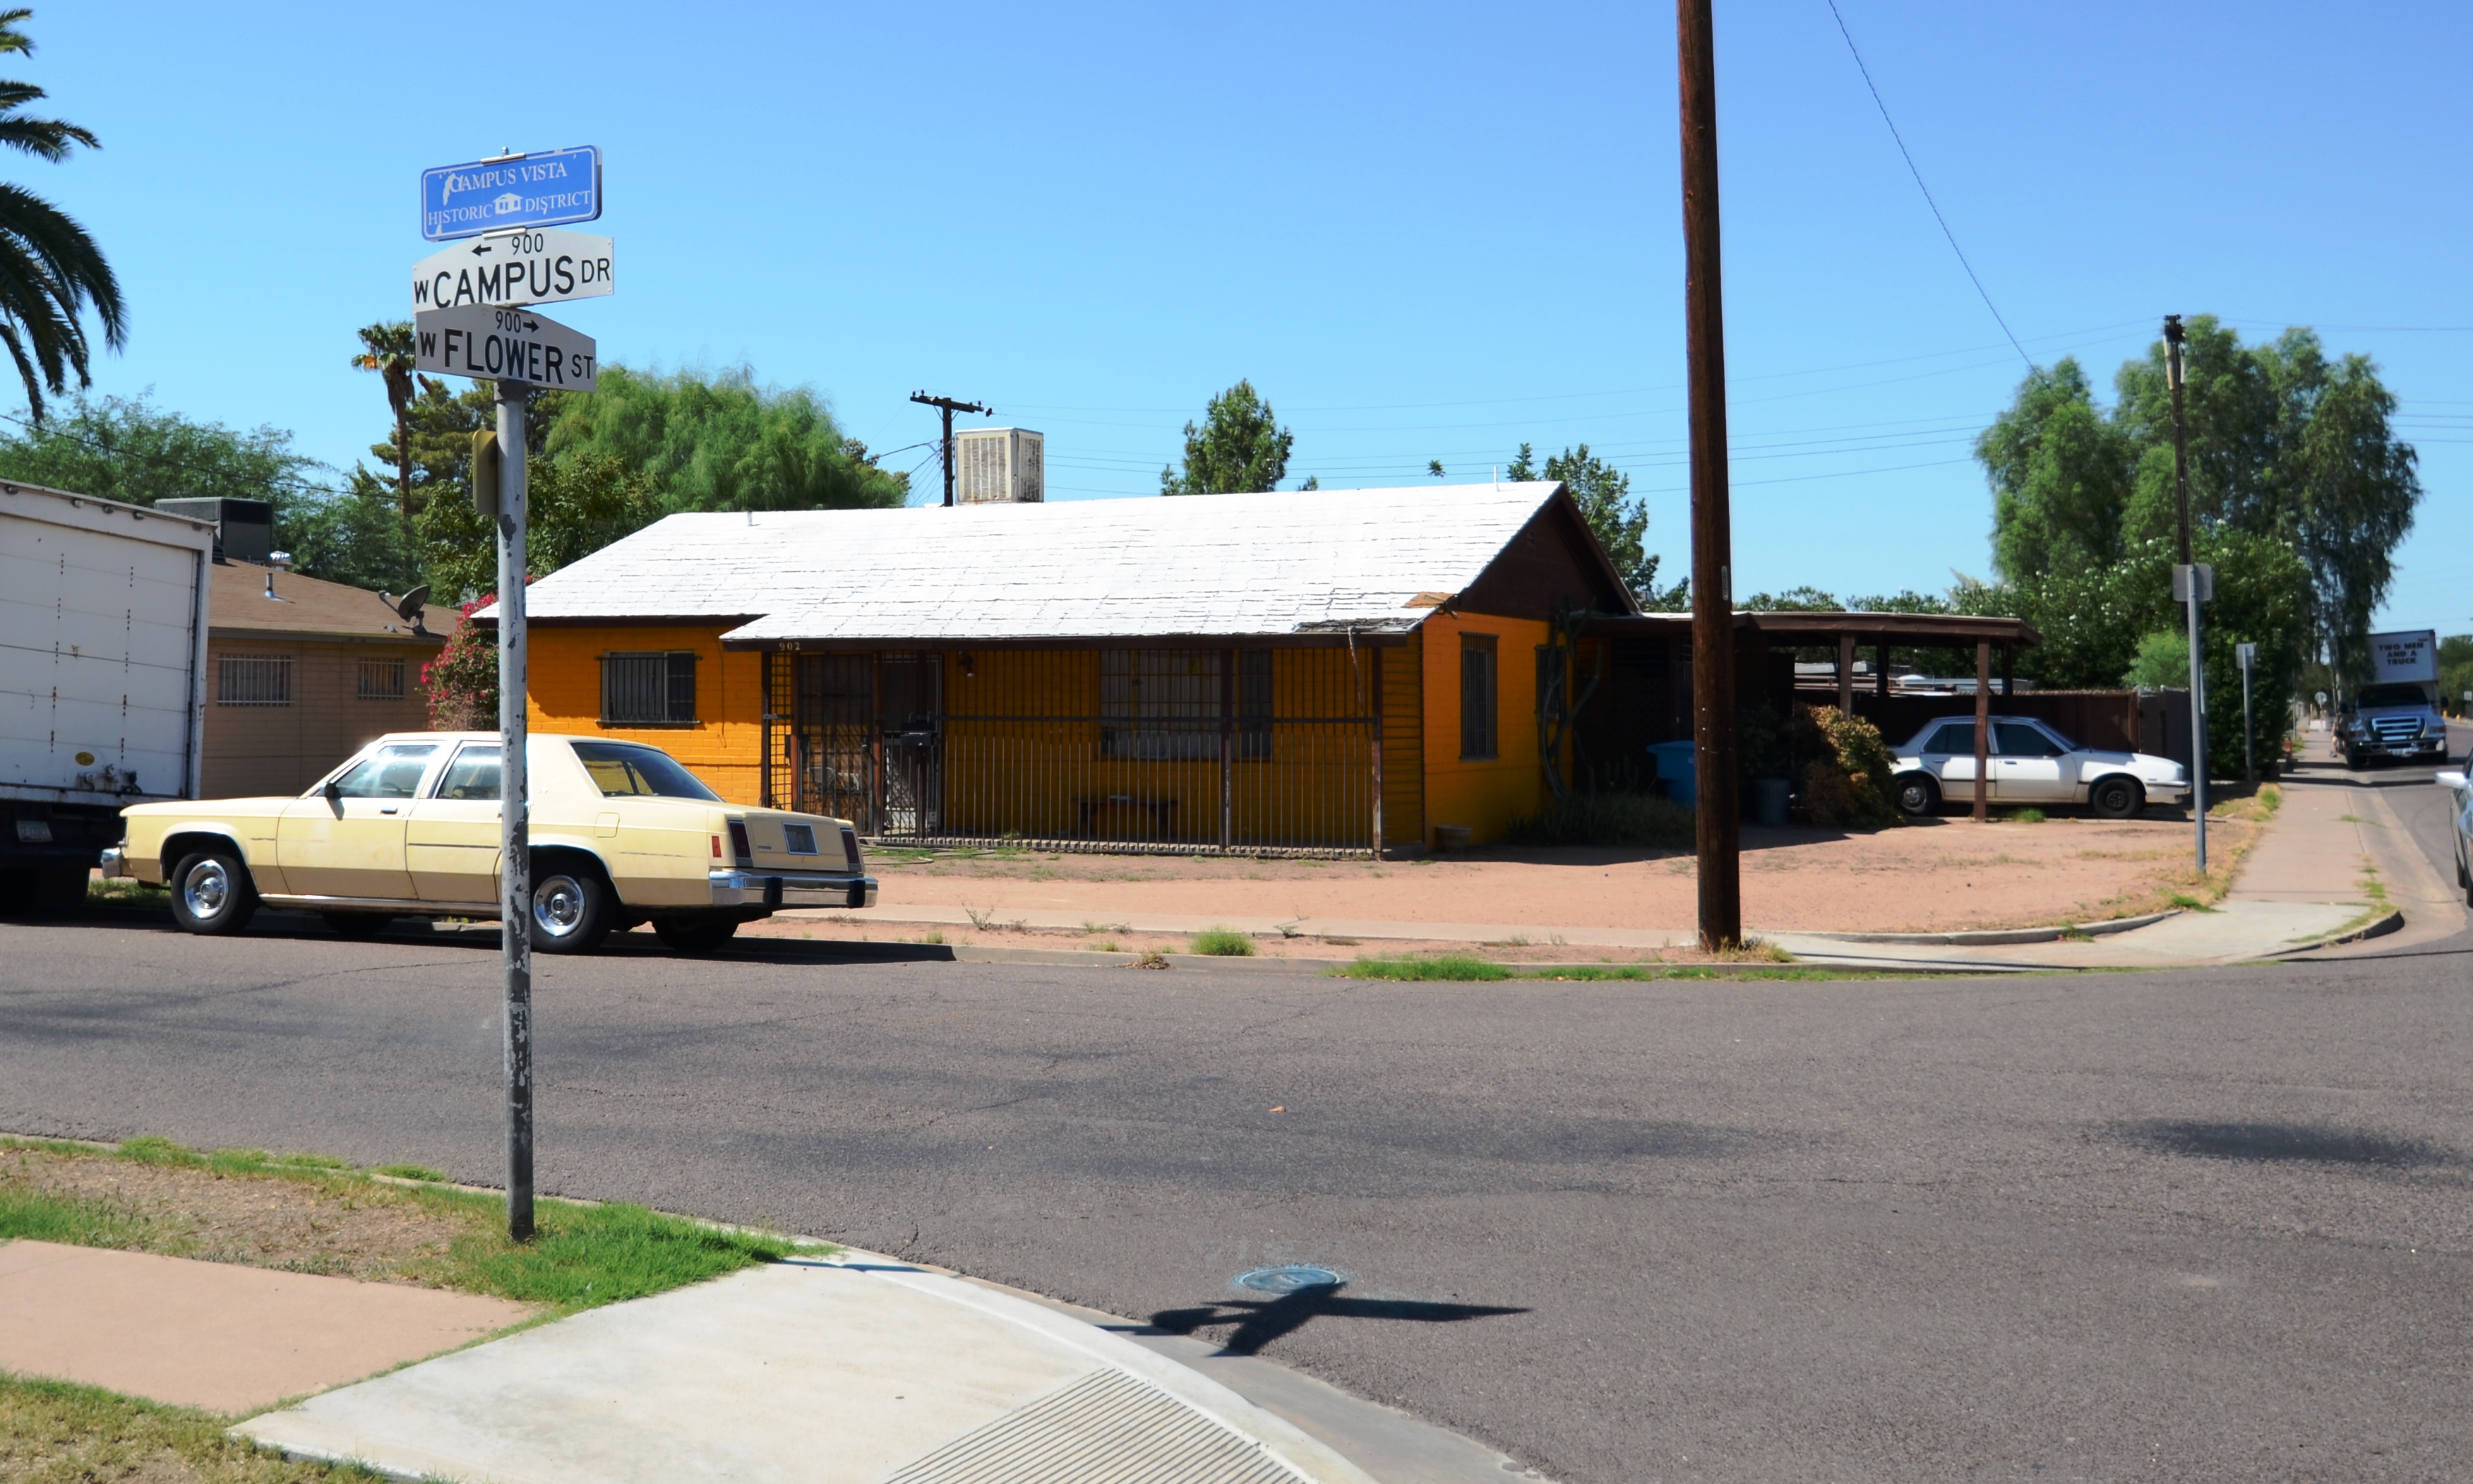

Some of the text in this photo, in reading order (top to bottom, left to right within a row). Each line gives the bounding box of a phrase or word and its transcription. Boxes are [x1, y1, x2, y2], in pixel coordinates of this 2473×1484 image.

[450, 162, 568, 193] CAMPUS VISTA
[428, 190, 591, 225] HISTORIC DISTRICT
[511, 233, 544, 256] 900
[414, 255, 611, 309] W CAMPUS DR
[496, 310, 522, 333] 900
[419, 328, 594, 385] W FLOWER ST
[779, 642, 801, 651] 902
